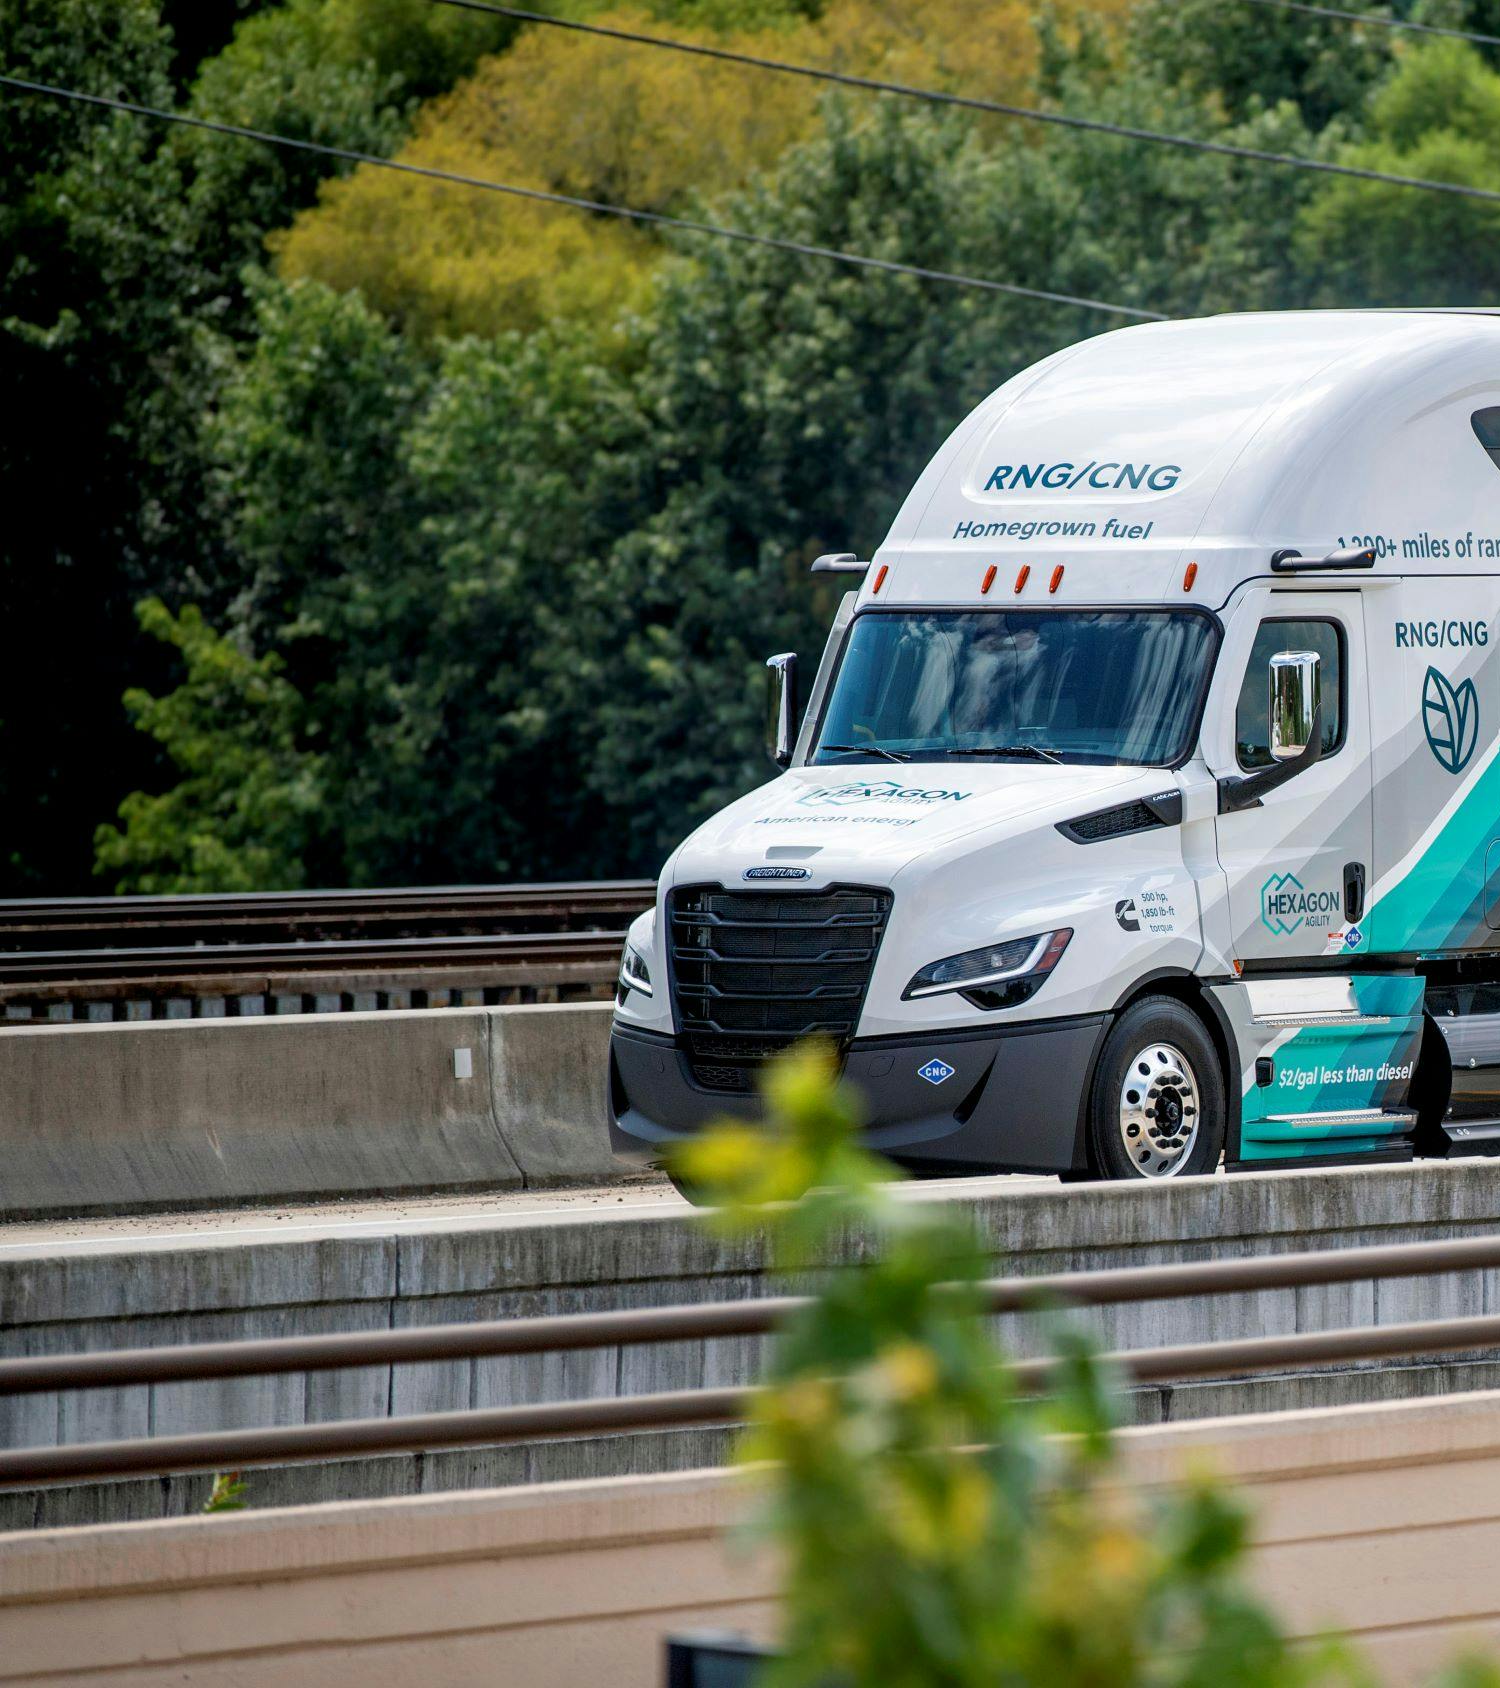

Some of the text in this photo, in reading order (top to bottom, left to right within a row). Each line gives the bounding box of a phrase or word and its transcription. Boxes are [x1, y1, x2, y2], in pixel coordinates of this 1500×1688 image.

[984, 461, 1182, 491] RNG/CNG
[953, 518, 1154, 540] Homegrown fuel
[1402, 532, 1450, 559] miles
[1455, 531, 1472, 559] of
[1395, 620, 1489, 648] RNG/CNG
[814, 788, 972, 801] HEXAGON
[754, 815, 922, 827] American energy
[748, 868, 805, 877] FREIGHTLINER
[1141, 893, 1154, 902] 500
[1268, 892, 1339, 915] HEXAGON
[1305, 915, 1330, 928] AGILITY
[1149, 923, 1174, 934] torque
[925, 1067, 947, 1077] CNG
[1279, 1061, 1413, 1091] $2/gal less than diesel
